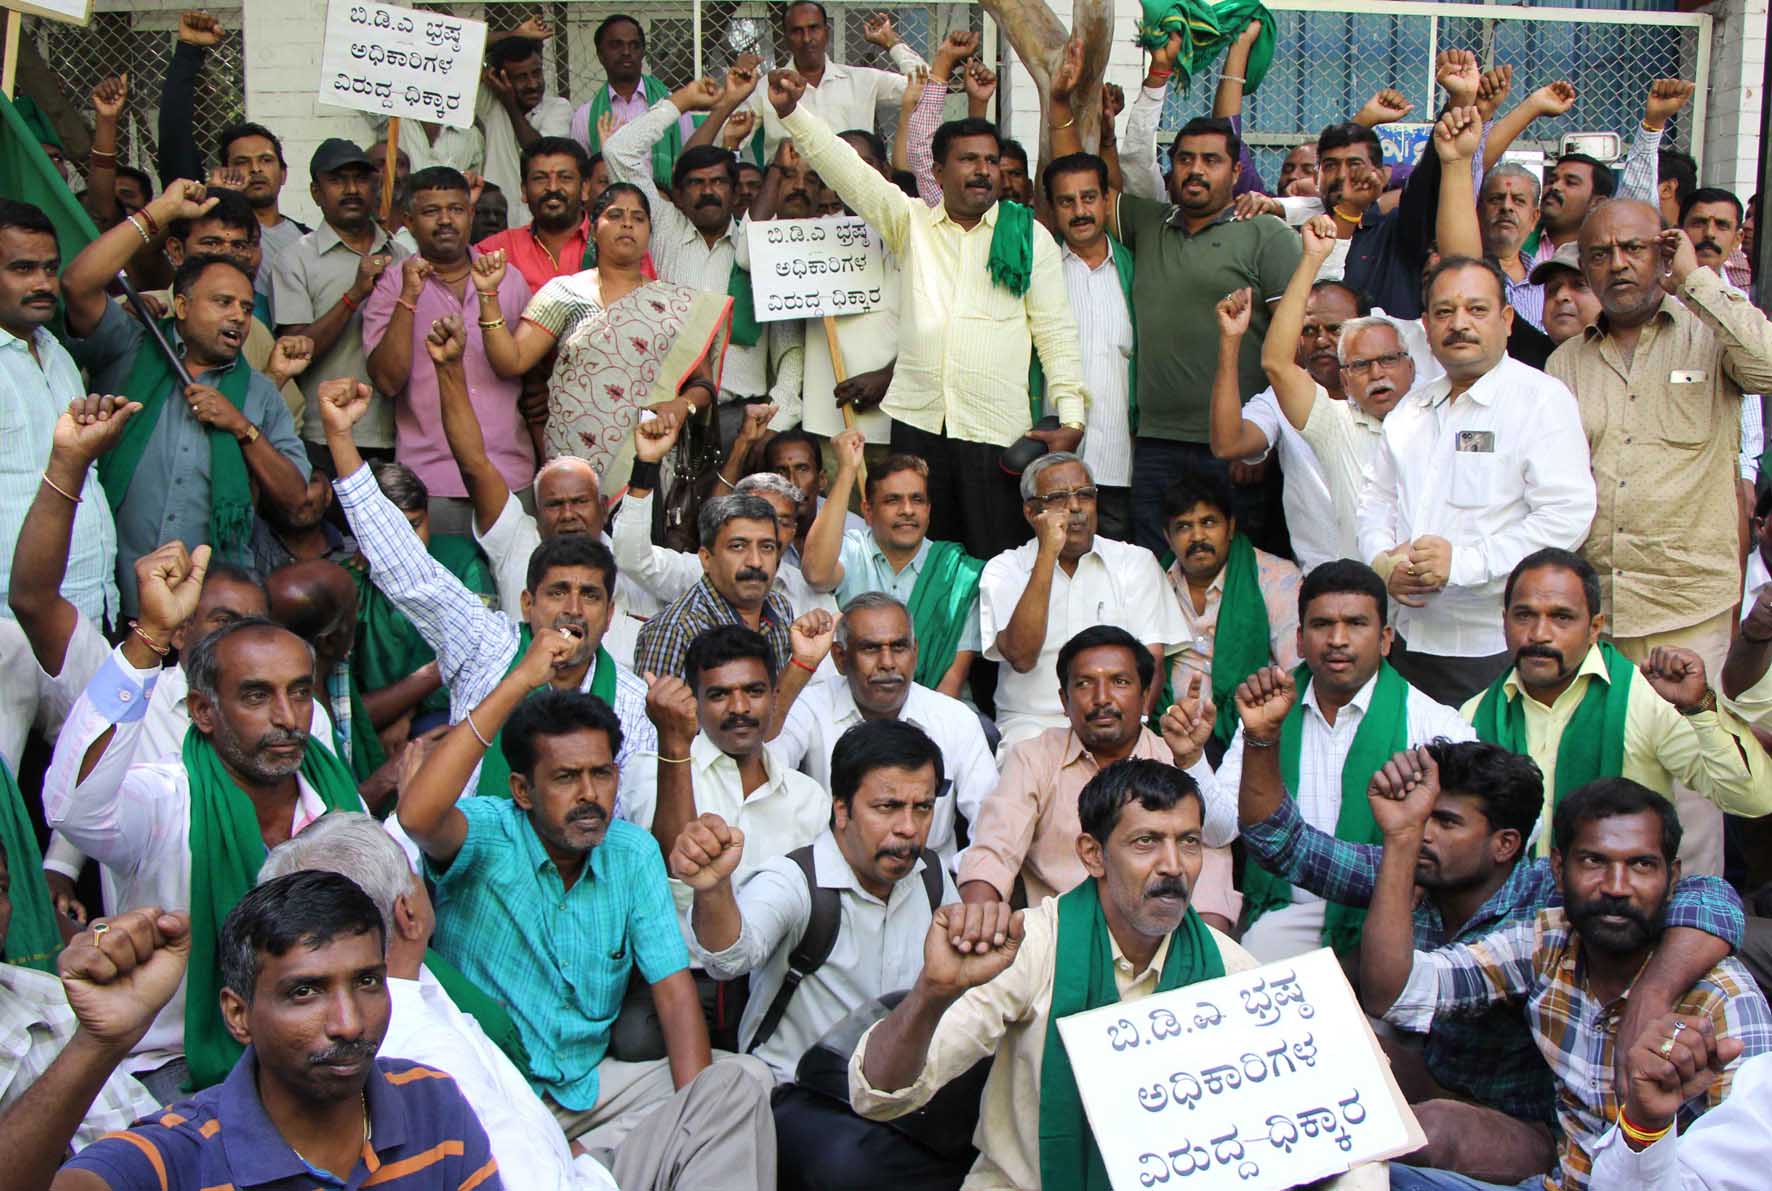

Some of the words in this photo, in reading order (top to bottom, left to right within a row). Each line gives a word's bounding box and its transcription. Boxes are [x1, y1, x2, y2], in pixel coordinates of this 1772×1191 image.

[351, 43, 453, 74] ಅಧಿಕಾರಿಗಳ
[404, 86, 461, 119] ಧಿಕ್ಕಾರ
[776, 253, 867, 279] ಅಧಿಕಾರಿಗಳ
[1138, 1031, 1318, 1112] ಅಧಿಕಾರಿಗಳ
[1265, 1087, 1366, 1151] ಧಿಕ್ಕಾರ
